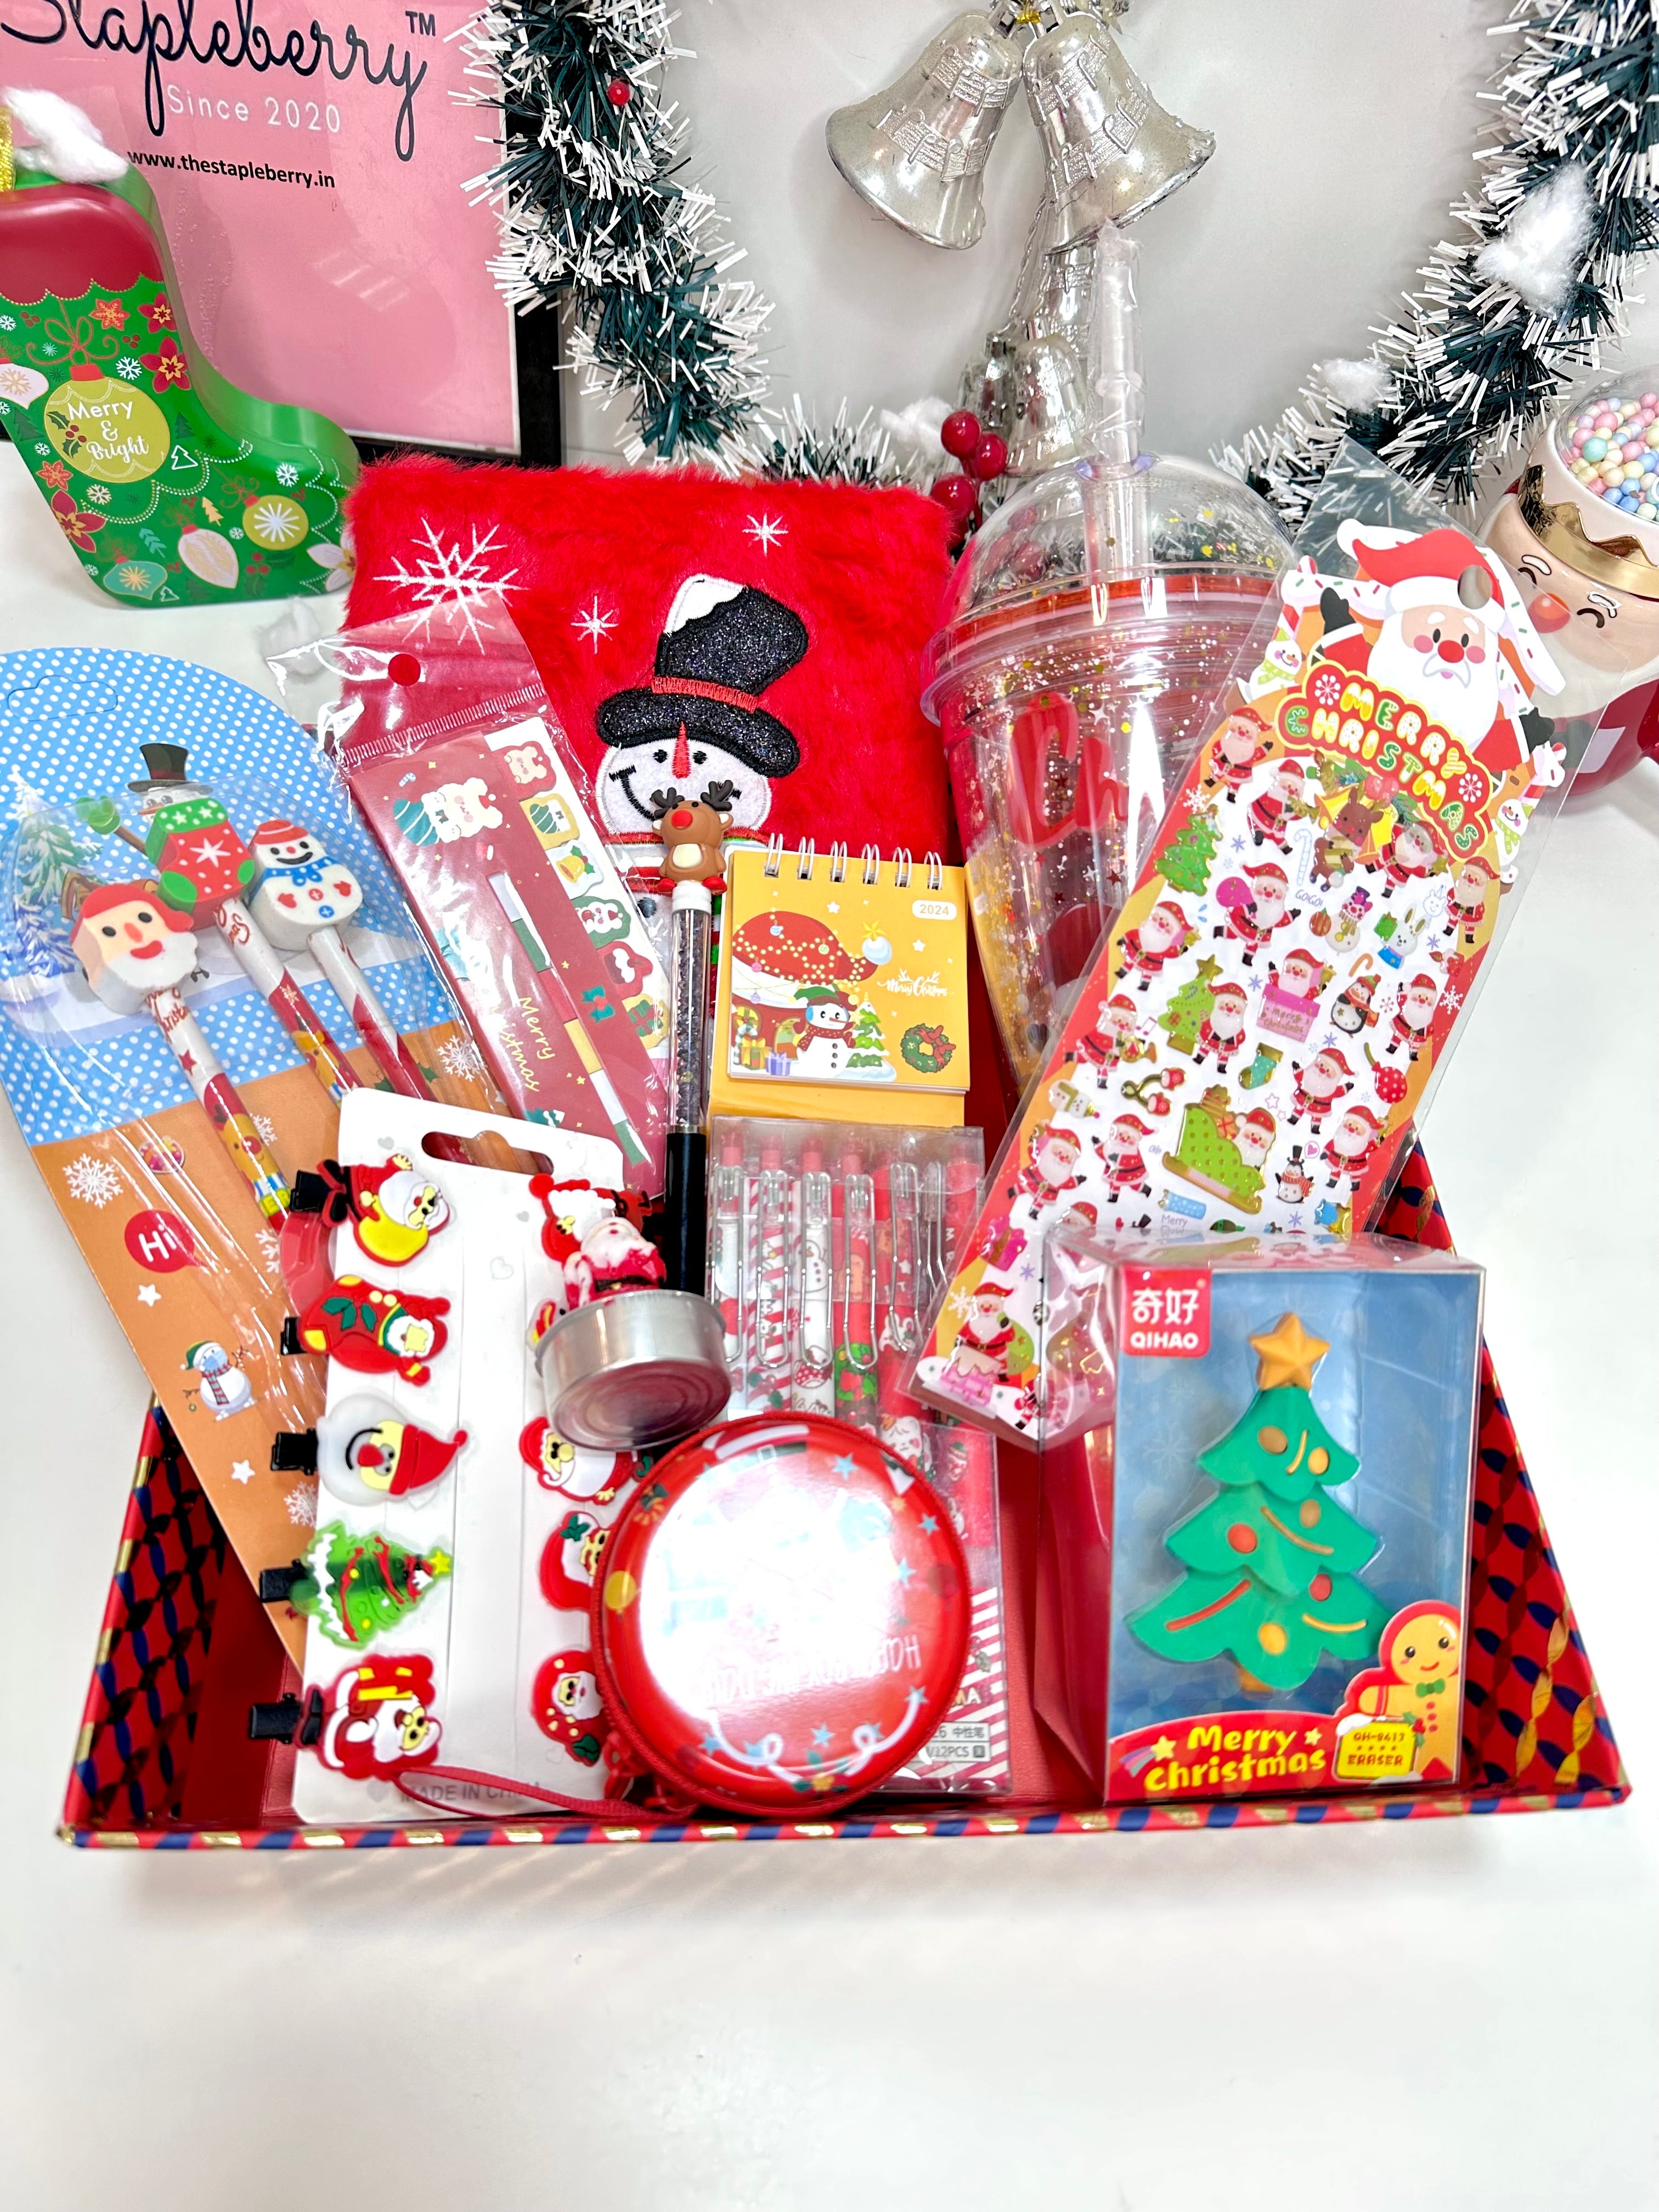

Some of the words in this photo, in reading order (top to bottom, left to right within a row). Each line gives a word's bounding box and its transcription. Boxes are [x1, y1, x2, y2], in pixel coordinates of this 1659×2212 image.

[166, 83, 249, 122] Since
[264, 97, 341, 134] 2020
[127, 150, 335, 188] www.thestapleberry.in
[67, 400, 133, 421] Merry
[101, 420, 118, 440] &
[87, 436, 149, 465] Bright
[1340, 682, 1467, 778] MERRY
[1285, 703, 1479, 852] CHRISTMAS
[919, 903, 950, 916] 2024
[519, 997, 556, 1060] Merry
[1161, 1214, 1188, 1228] Merry
[139, 1224, 177, 1263] Hi
[1132, 1287, 1199, 1324] 奇好
[1131, 1331, 1198, 1350] QIHAO
[1187, 1725, 1297, 1756] Merry
[1347, 1754, 1403, 1765] ERASER
[462, 1784, 480, 1799] IN
